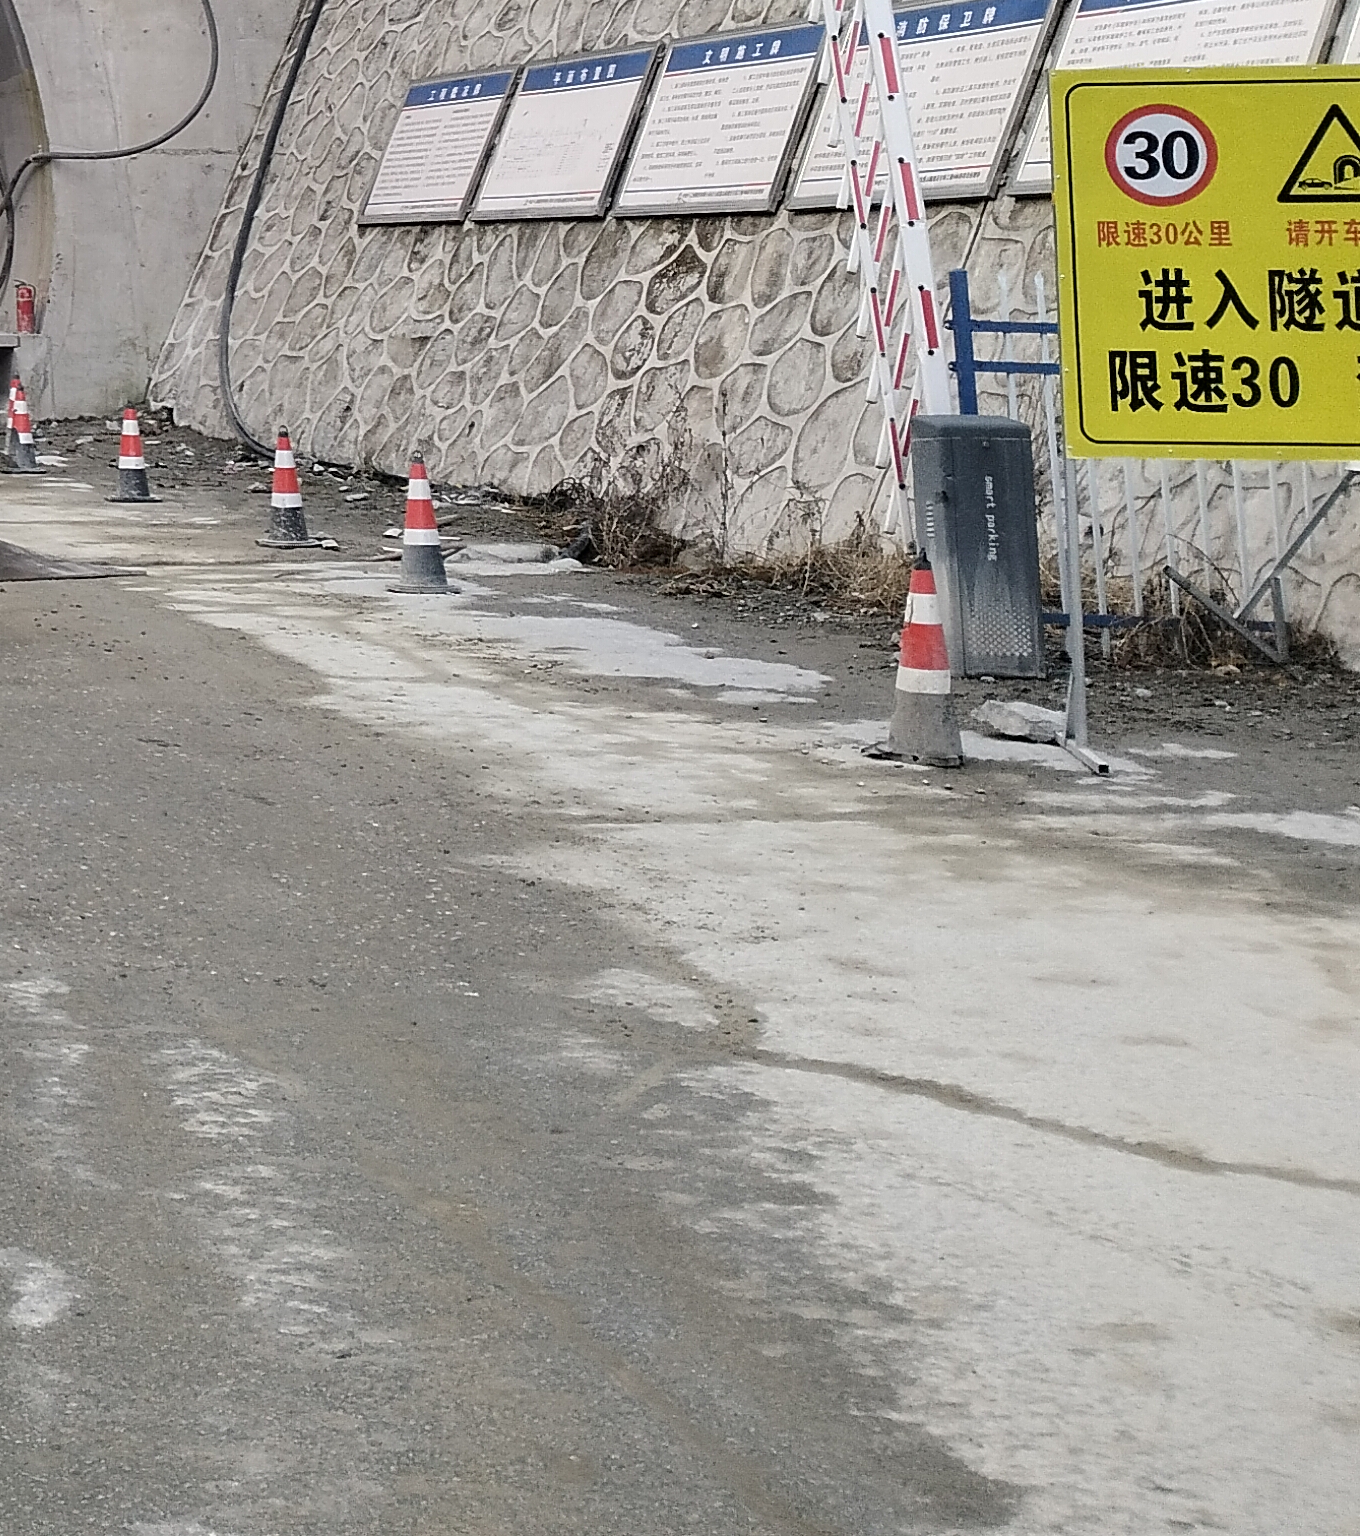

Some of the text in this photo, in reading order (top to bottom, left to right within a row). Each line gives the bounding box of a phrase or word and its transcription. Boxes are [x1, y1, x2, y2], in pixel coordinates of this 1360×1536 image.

[896, 6, 997, 37] 消防保卫牌
[702, 39, 782, 65] 文明施工牌
[1122, 130, 1200, 181] 30
[1096, 219, 1234, 248] 限速30公里
[1108, 348, 1301, 413] 限速30
[984, 475, 1000, 562] smart parking
